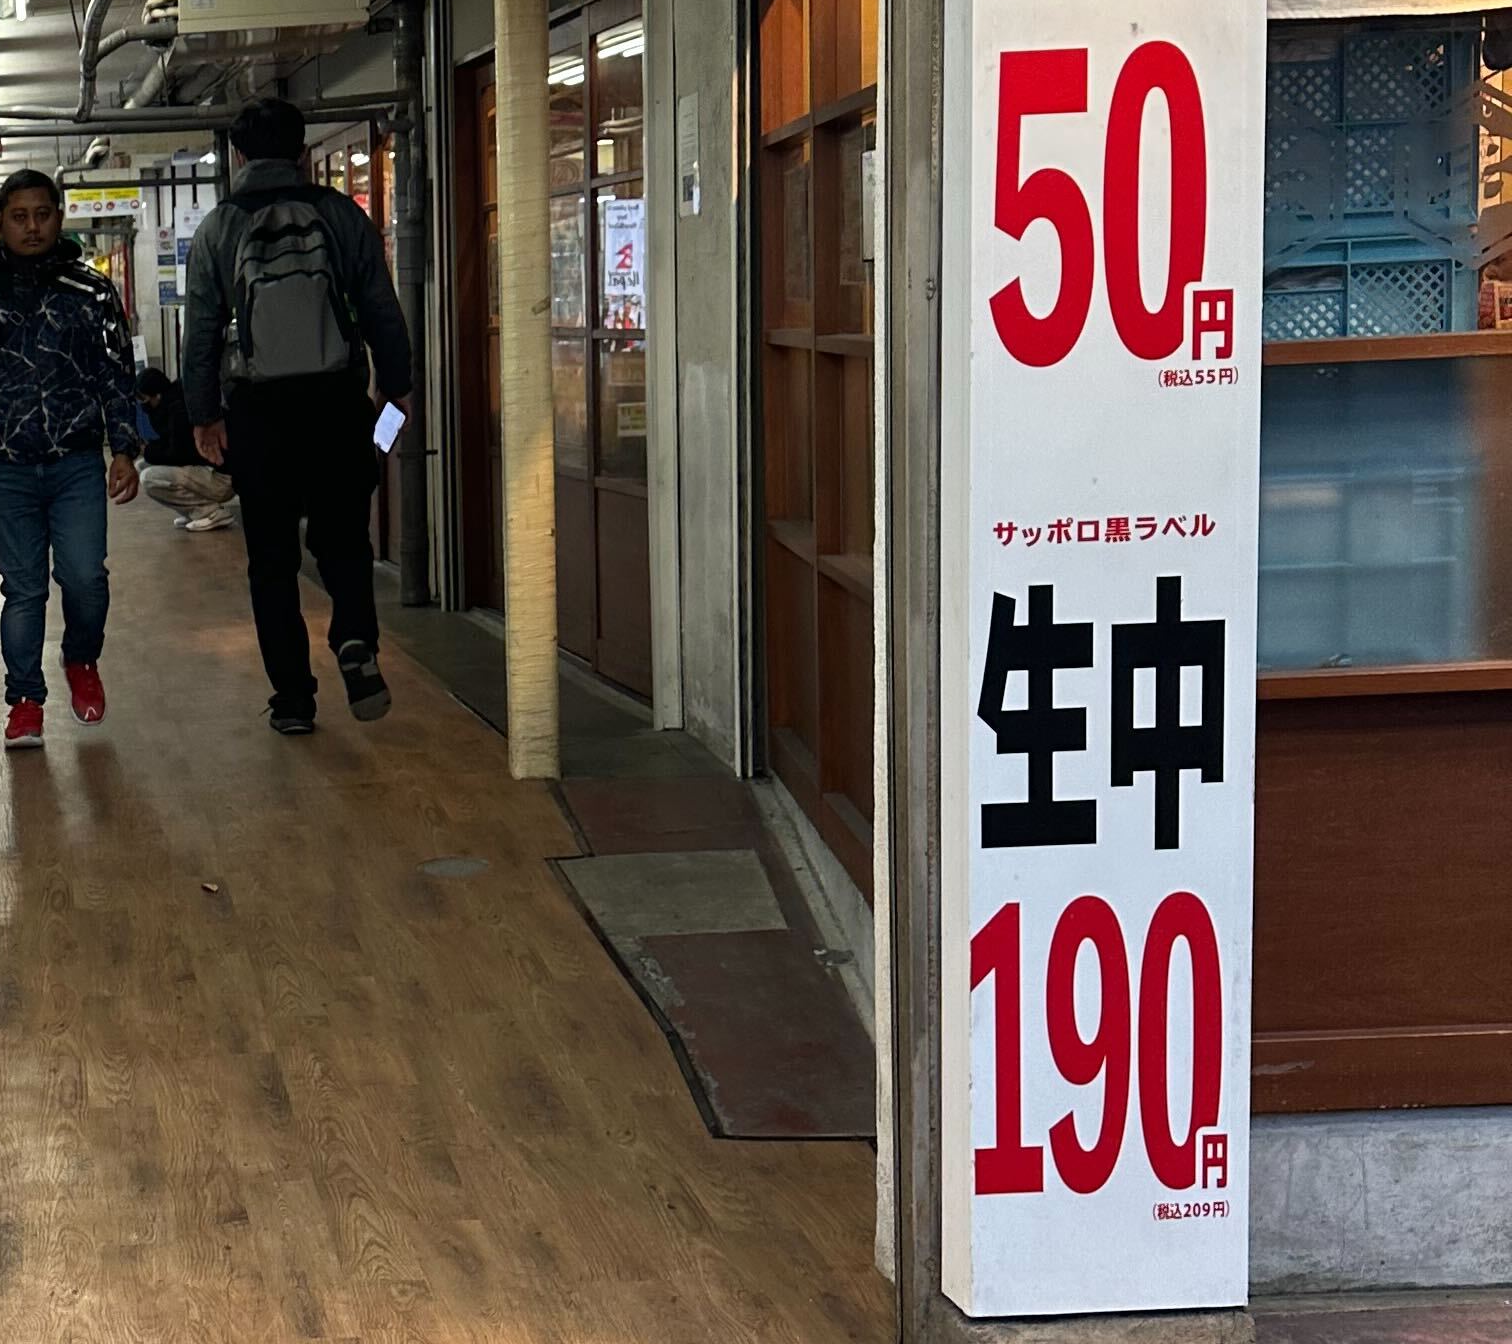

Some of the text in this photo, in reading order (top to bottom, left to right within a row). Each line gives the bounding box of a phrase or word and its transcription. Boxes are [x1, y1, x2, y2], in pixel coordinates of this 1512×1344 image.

[988, 40, 1234, 368] 50円
[993, 513, 1216, 547] サッポロ黒ラベル
[977, 575, 1226, 850] 生中
[969, 891, 1228, 1195] 190円
